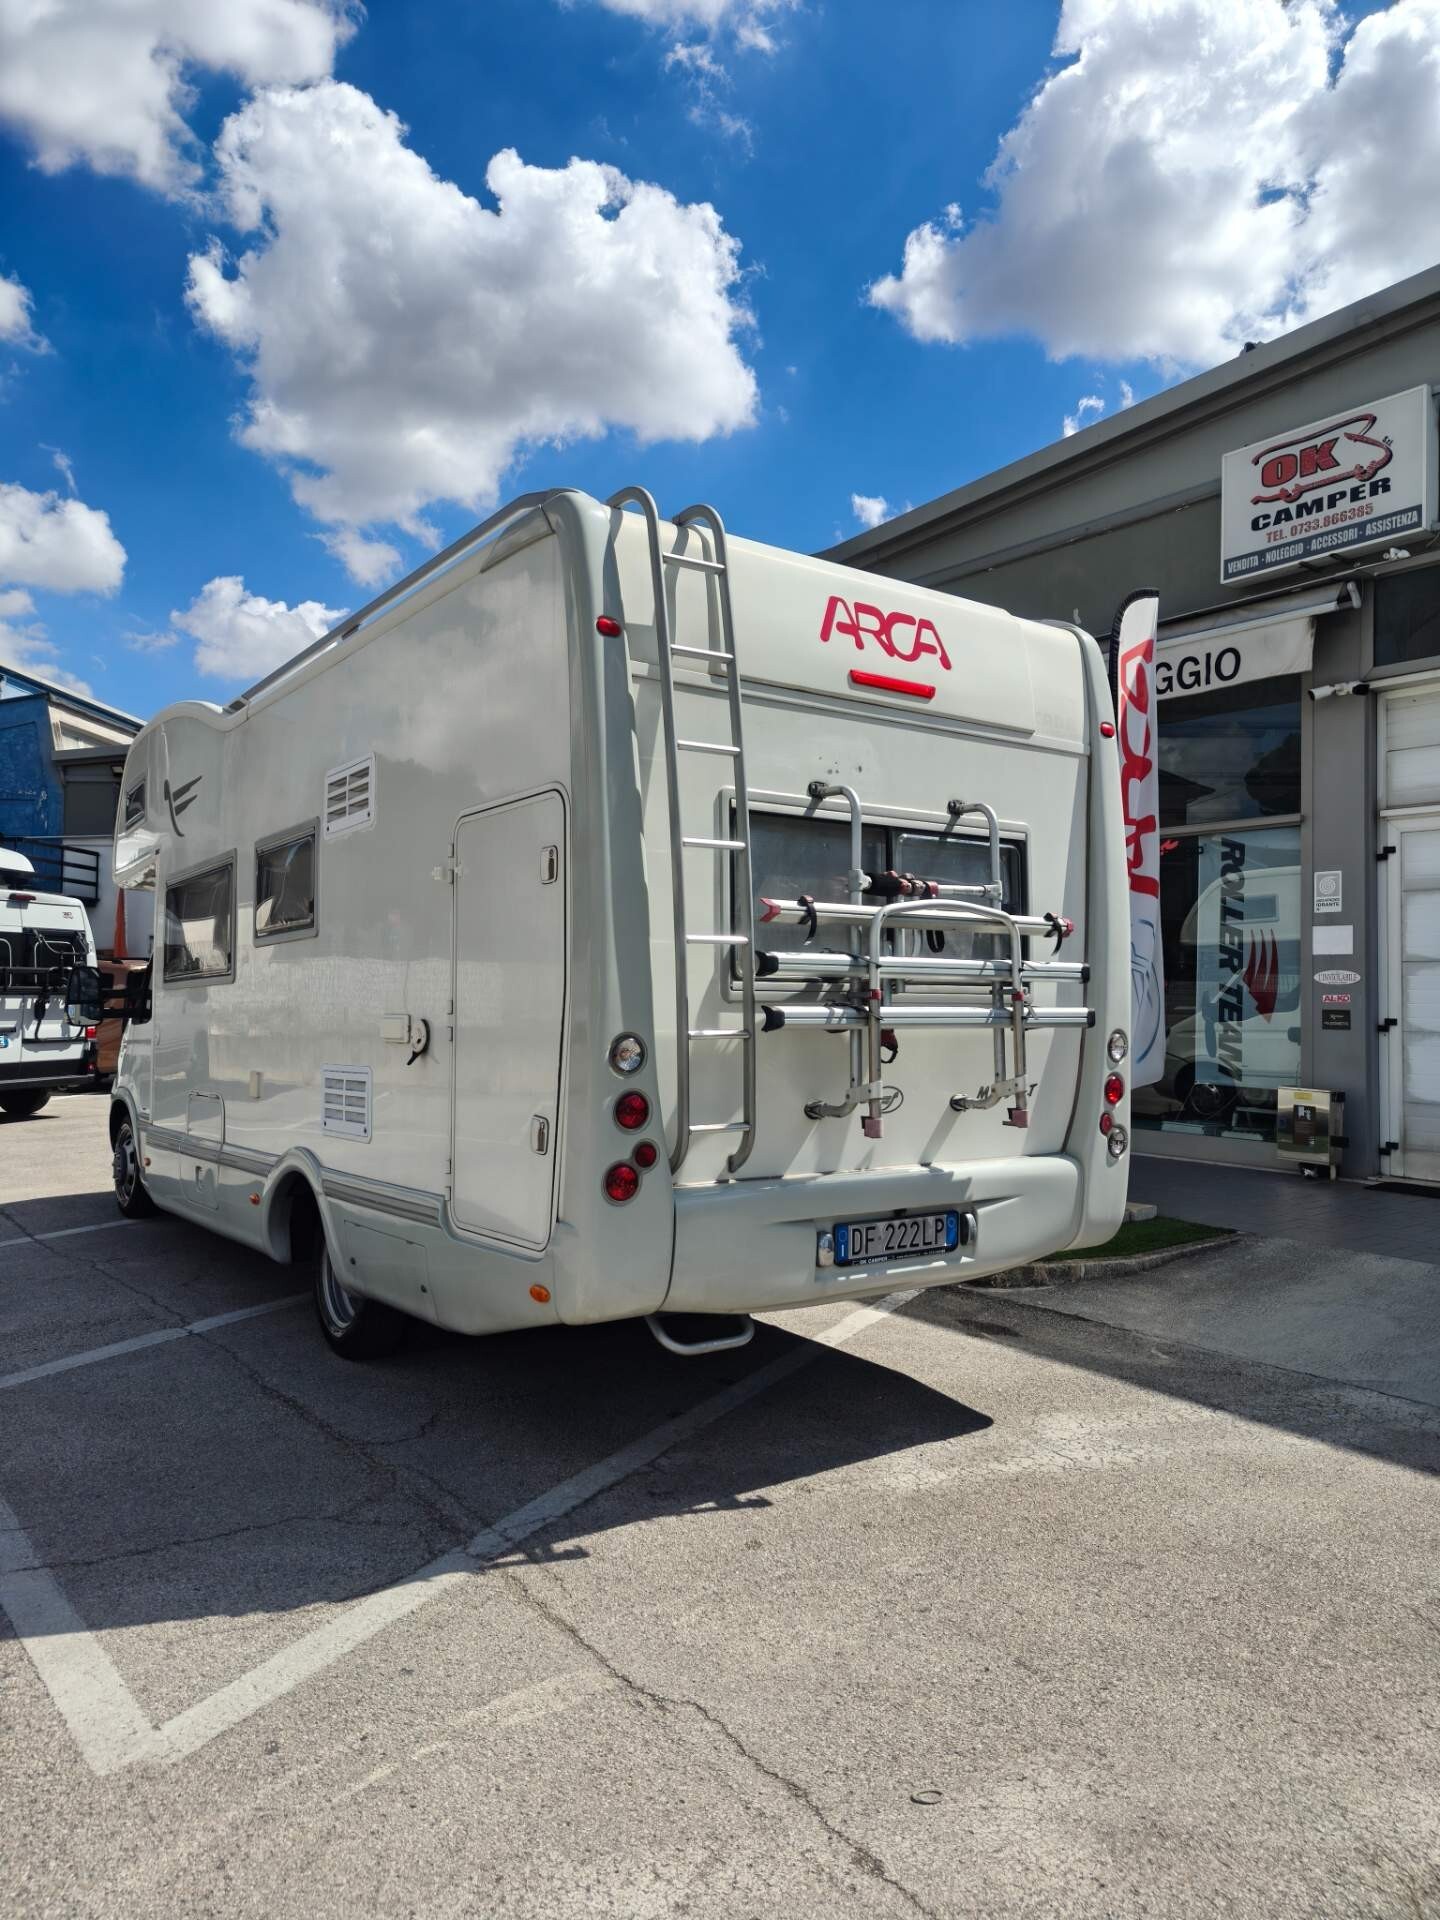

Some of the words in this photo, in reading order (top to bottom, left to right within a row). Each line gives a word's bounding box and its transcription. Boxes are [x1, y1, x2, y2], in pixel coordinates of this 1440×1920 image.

[1262, 437, 1341, 487] OK
[1251, 477, 1391, 532] CAMPER
[1266, 530, 1288, 543] TEL.
[1290, 502, 1374, 537] 0733.866385
[1228, 555, 1259, 574] VENDITA
[1266, 543, 1304, 564] NOLEGGIO
[1311, 527, 1358, 551] ACCESSORI
[1365, 510, 1418, 537] ASSISTENZA
[820, 595, 953, 671] ARCA
[851, 1226, 876, 1255] DF
[884, 1218, 945, 1251] 222LP
